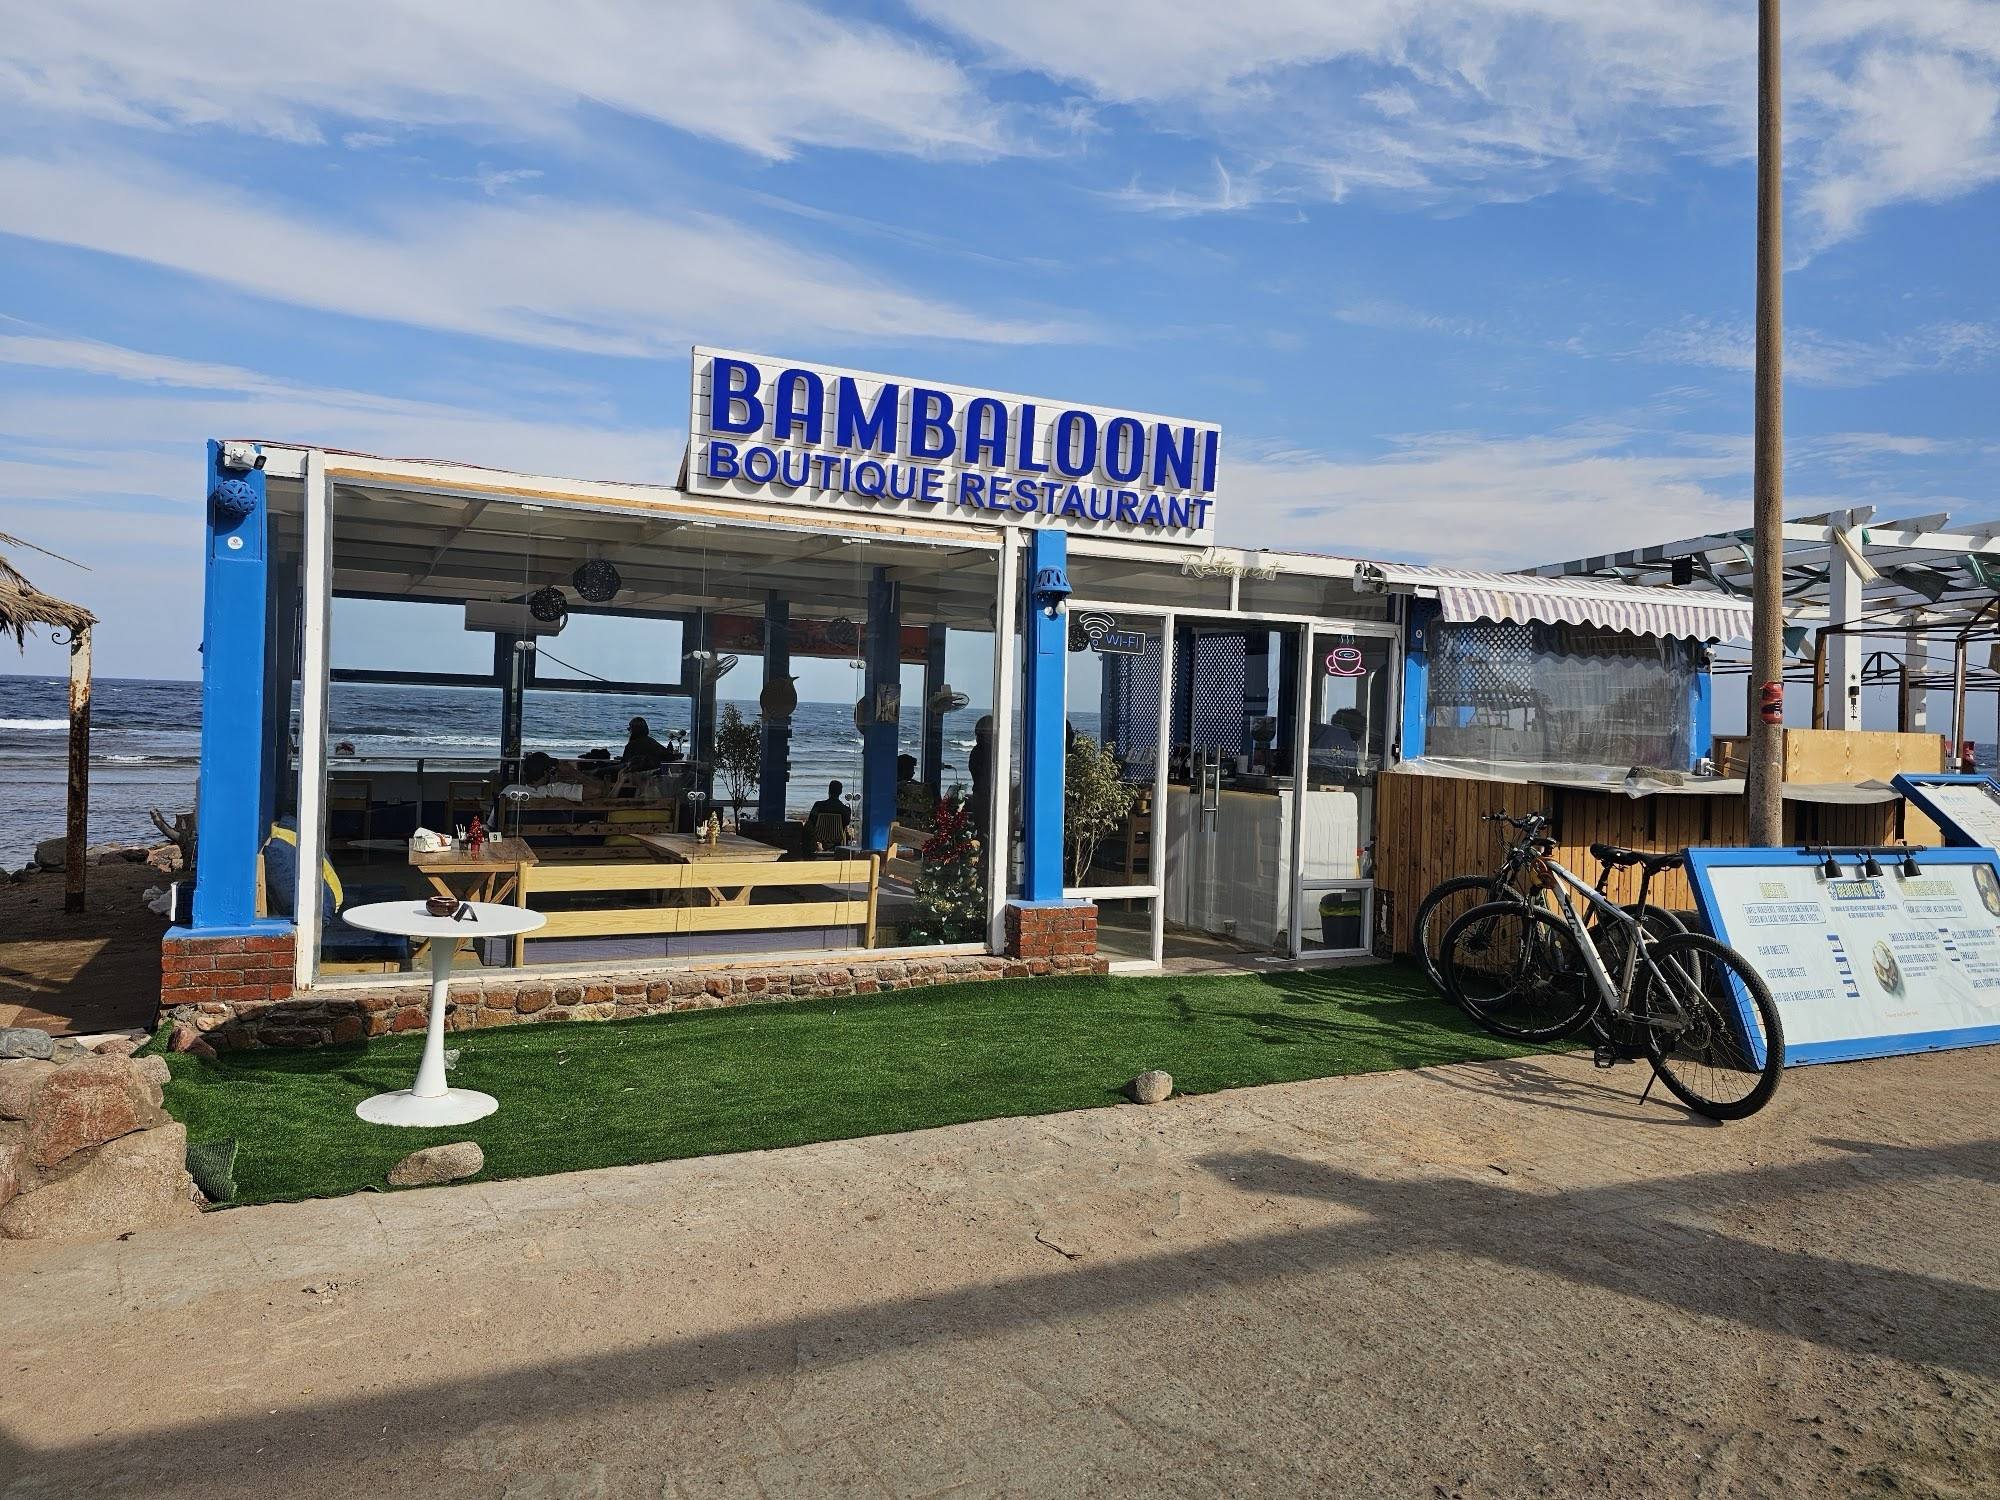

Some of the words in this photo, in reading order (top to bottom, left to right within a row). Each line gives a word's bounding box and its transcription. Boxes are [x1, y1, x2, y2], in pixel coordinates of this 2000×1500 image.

[710, 356, 1219, 492] BAMBALOONI
[707, 440, 945, 504] BOUTIQUE
[959, 472, 1213, 529] RESTAURANT
[1106, 633, 1139, 649] WI-FI
